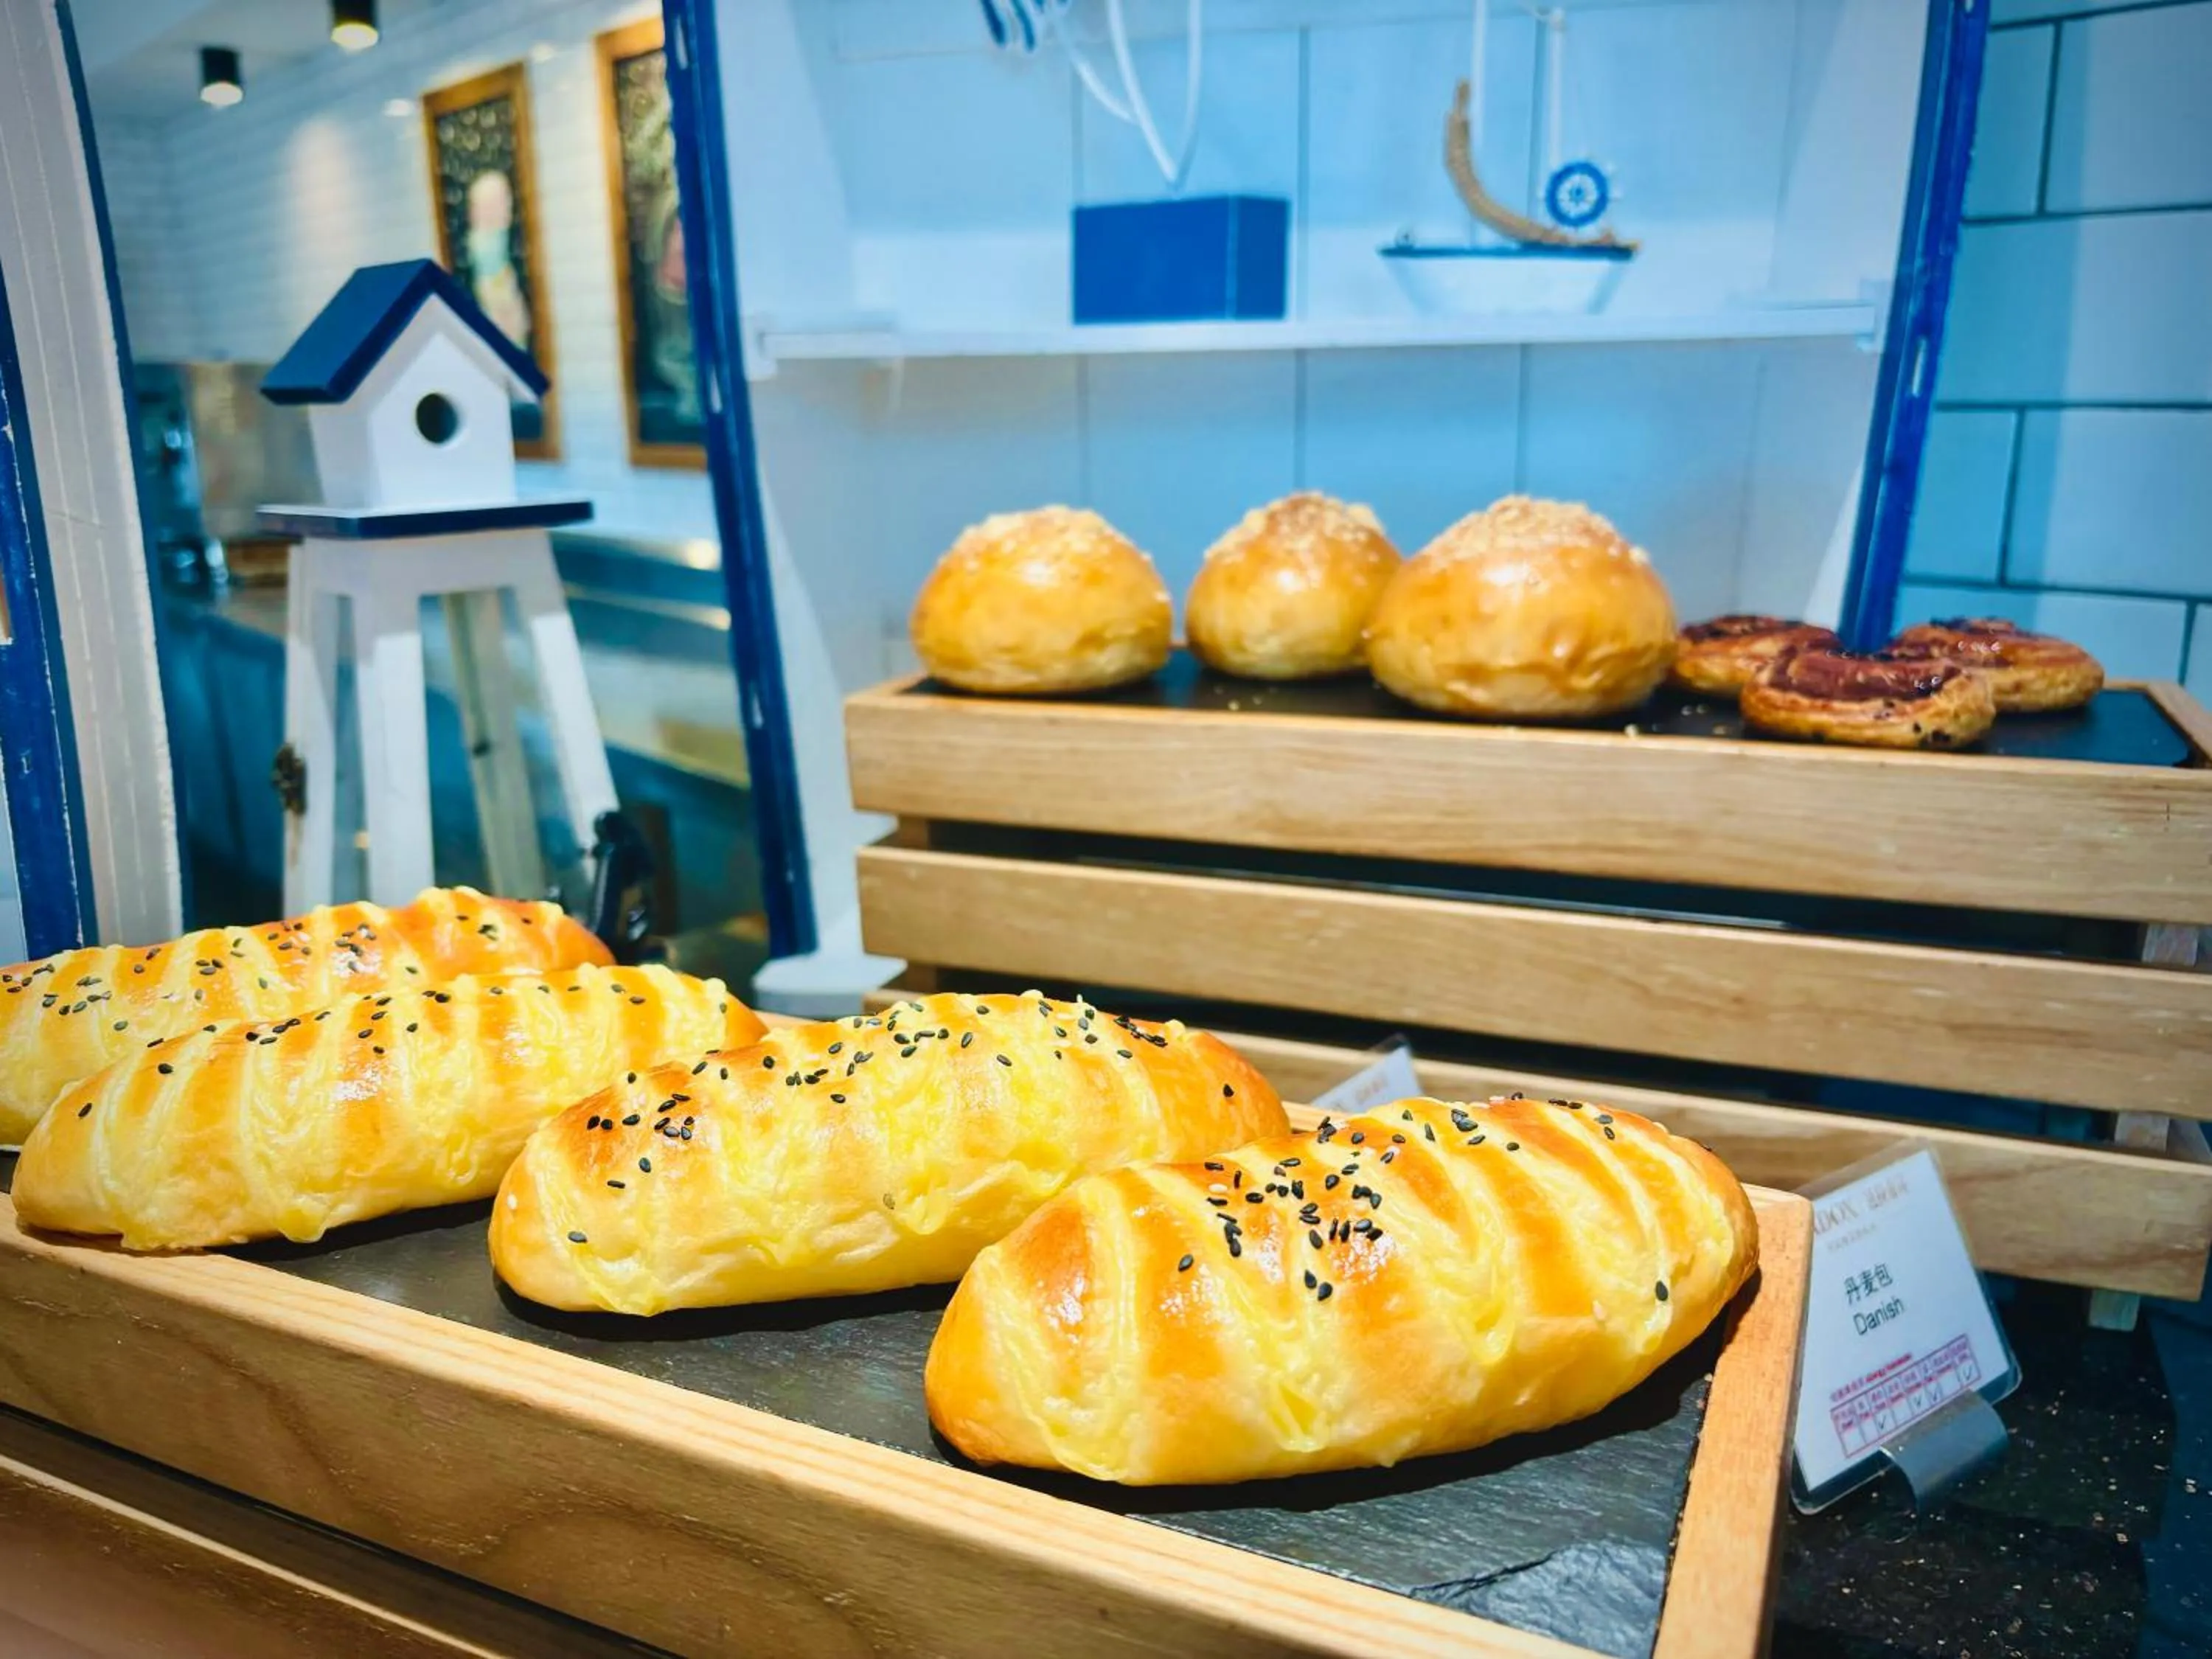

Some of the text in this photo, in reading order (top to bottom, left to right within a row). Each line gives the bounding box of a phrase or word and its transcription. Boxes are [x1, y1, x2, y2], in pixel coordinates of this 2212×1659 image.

[1844, 1263, 1893, 1304] 丹麦包
[1853, 1296, 1905, 1335] Danish
